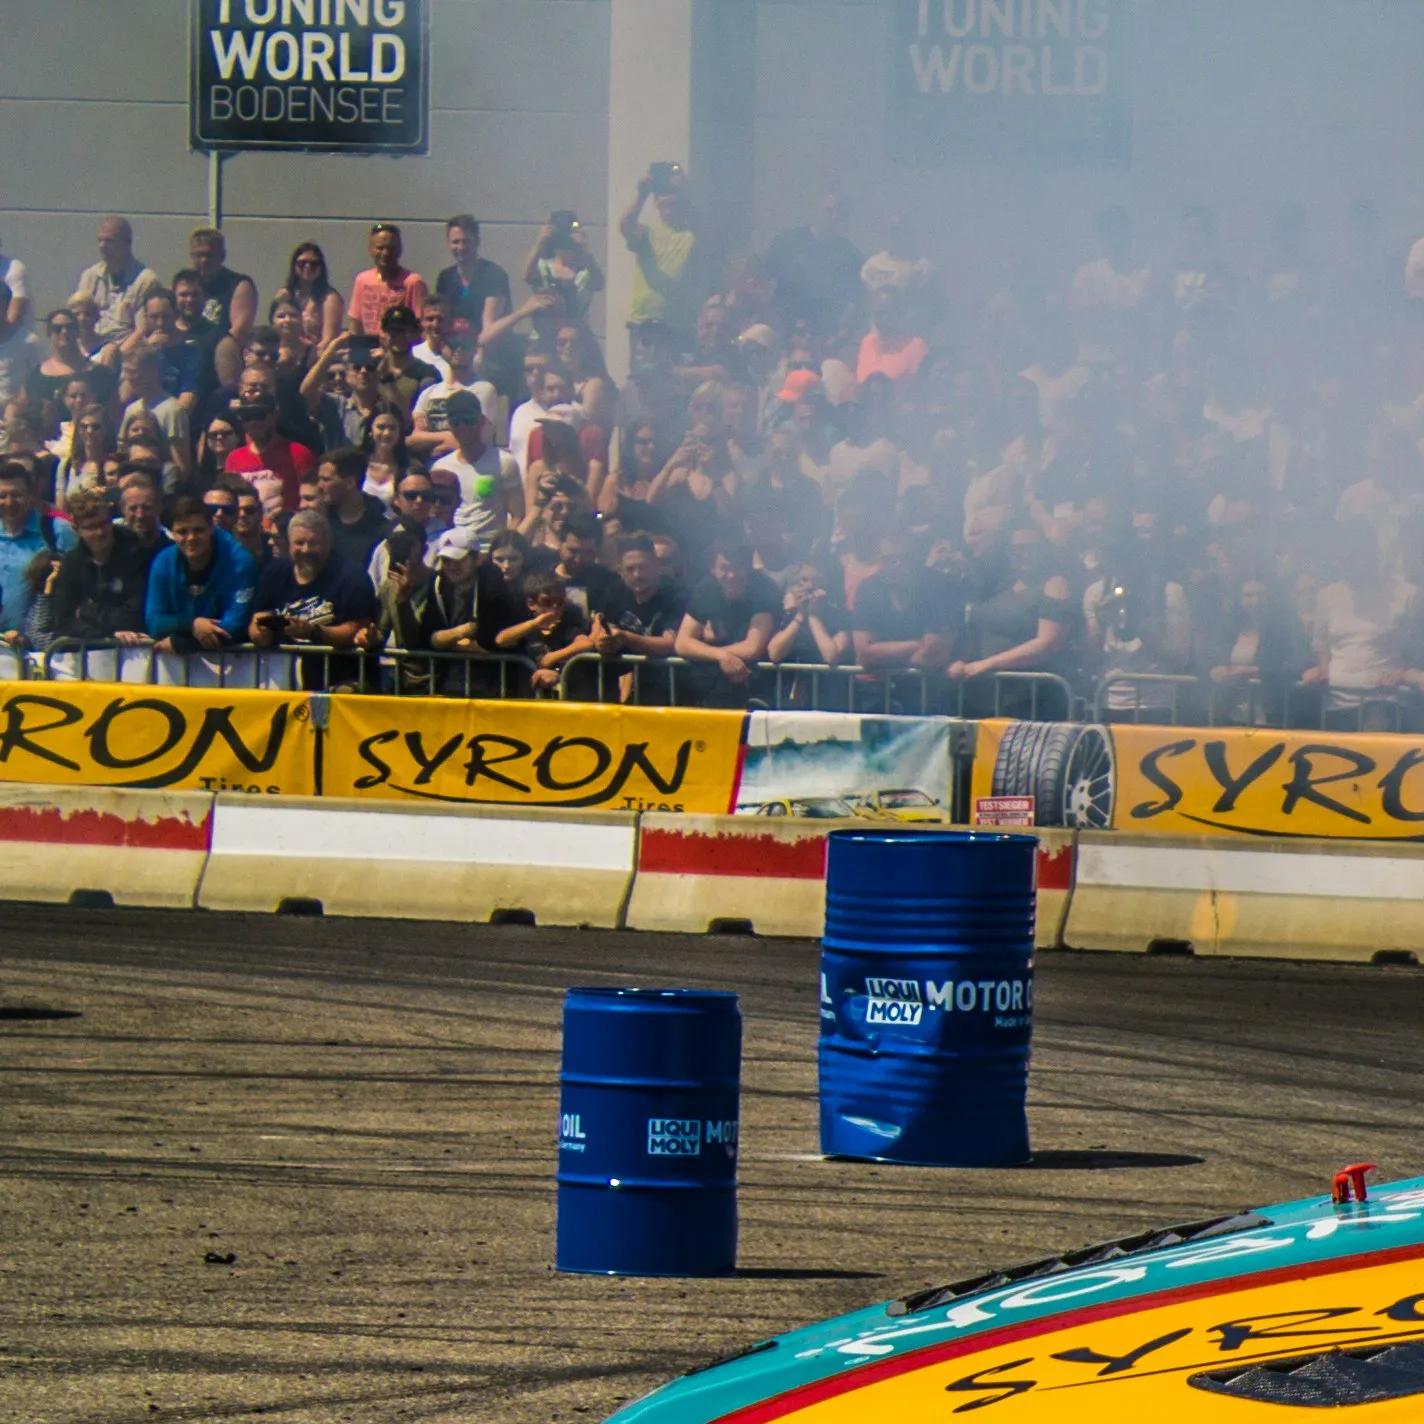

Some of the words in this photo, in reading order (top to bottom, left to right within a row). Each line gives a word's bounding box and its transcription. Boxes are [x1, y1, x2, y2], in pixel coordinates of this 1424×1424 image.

[210, 30, 406, 83] WORLD
[908, 43, 1109, 95] WORLD
[209, 84, 405, 124] BODENSEE
[868, 979, 918, 1000] LIQUI
[925, 979, 1024, 1012] MOTOR
[868, 1001, 921, 1024] MOLY
[562, 1113, 586, 1138] OIL
[650, 1120, 698, 1136] LIQUI
[650, 1138, 698, 1154] MOLY
